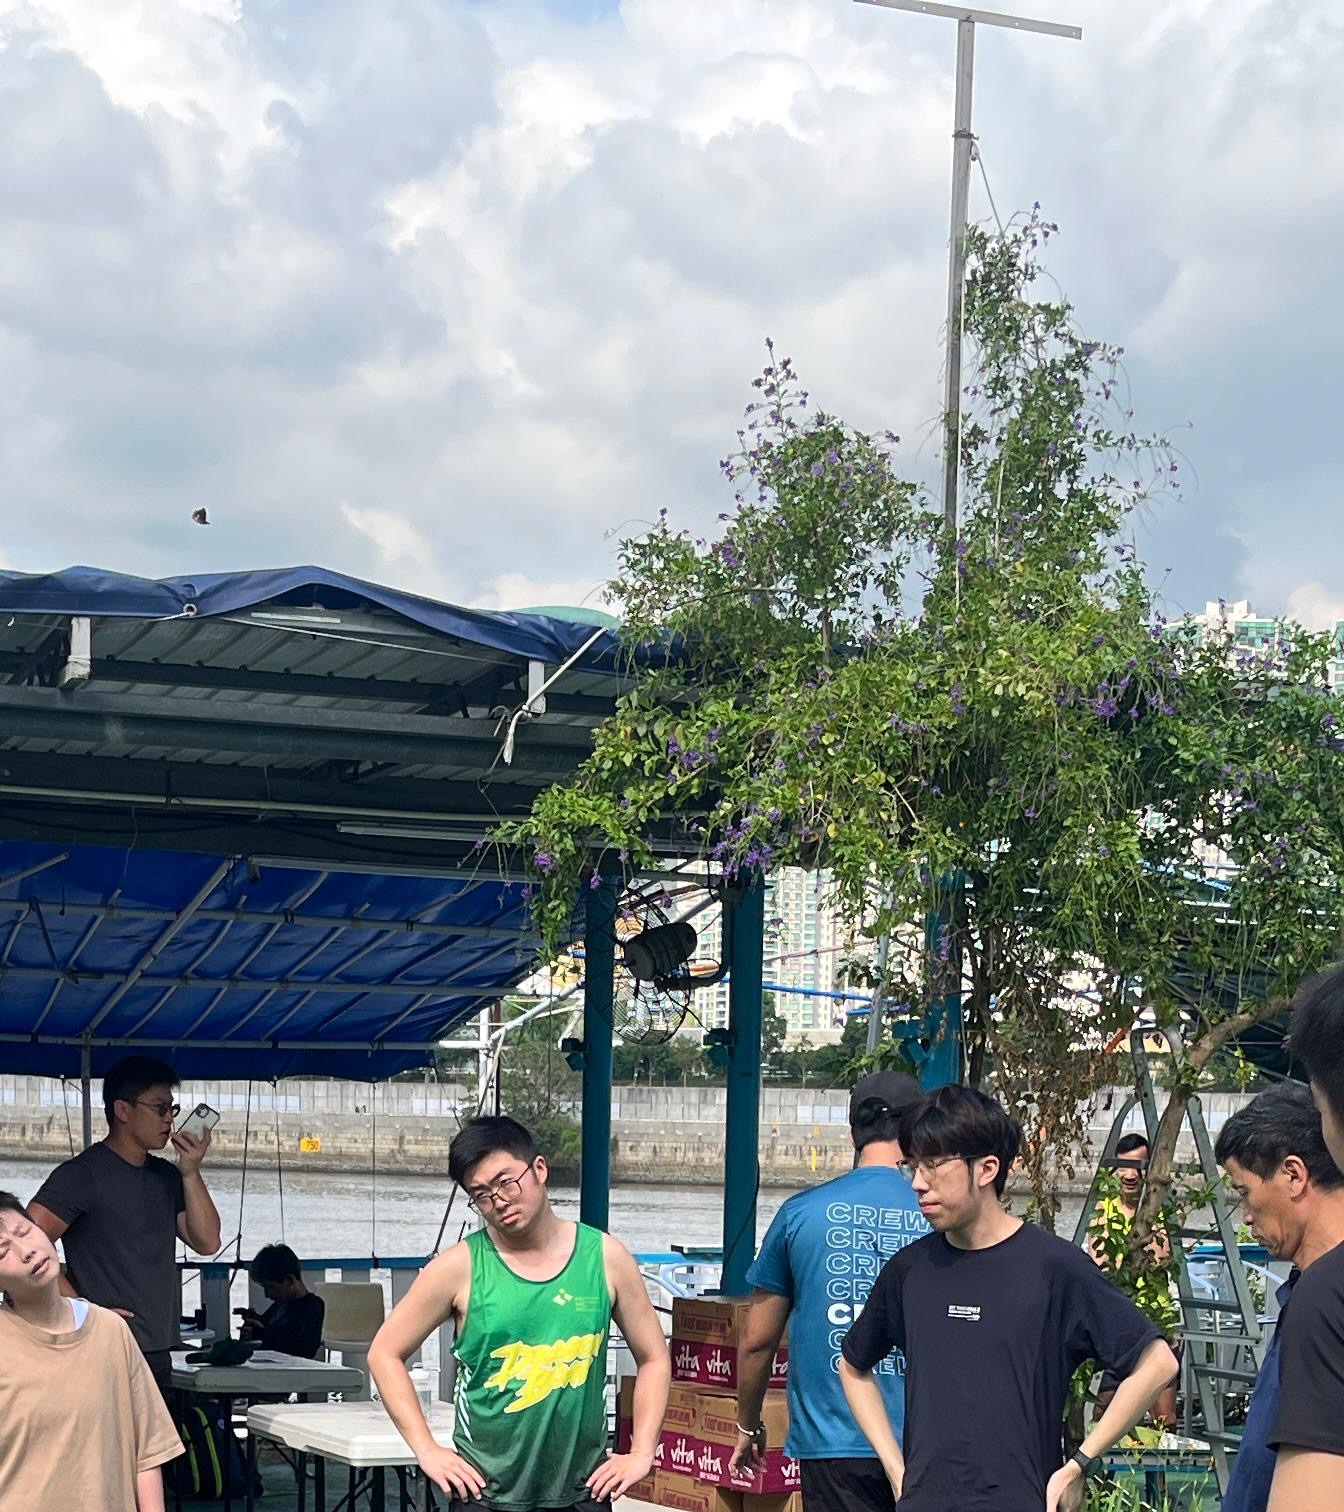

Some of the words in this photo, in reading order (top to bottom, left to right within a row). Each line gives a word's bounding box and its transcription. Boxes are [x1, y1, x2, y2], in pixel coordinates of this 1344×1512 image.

[826, 1202, 930, 1232] CREW
[675, 1344, 700, 1371] vita
[706, 1349, 731, 1376] vita
[671, 1438, 694, 1464] vita
[698, 1446, 723, 1475] vita
